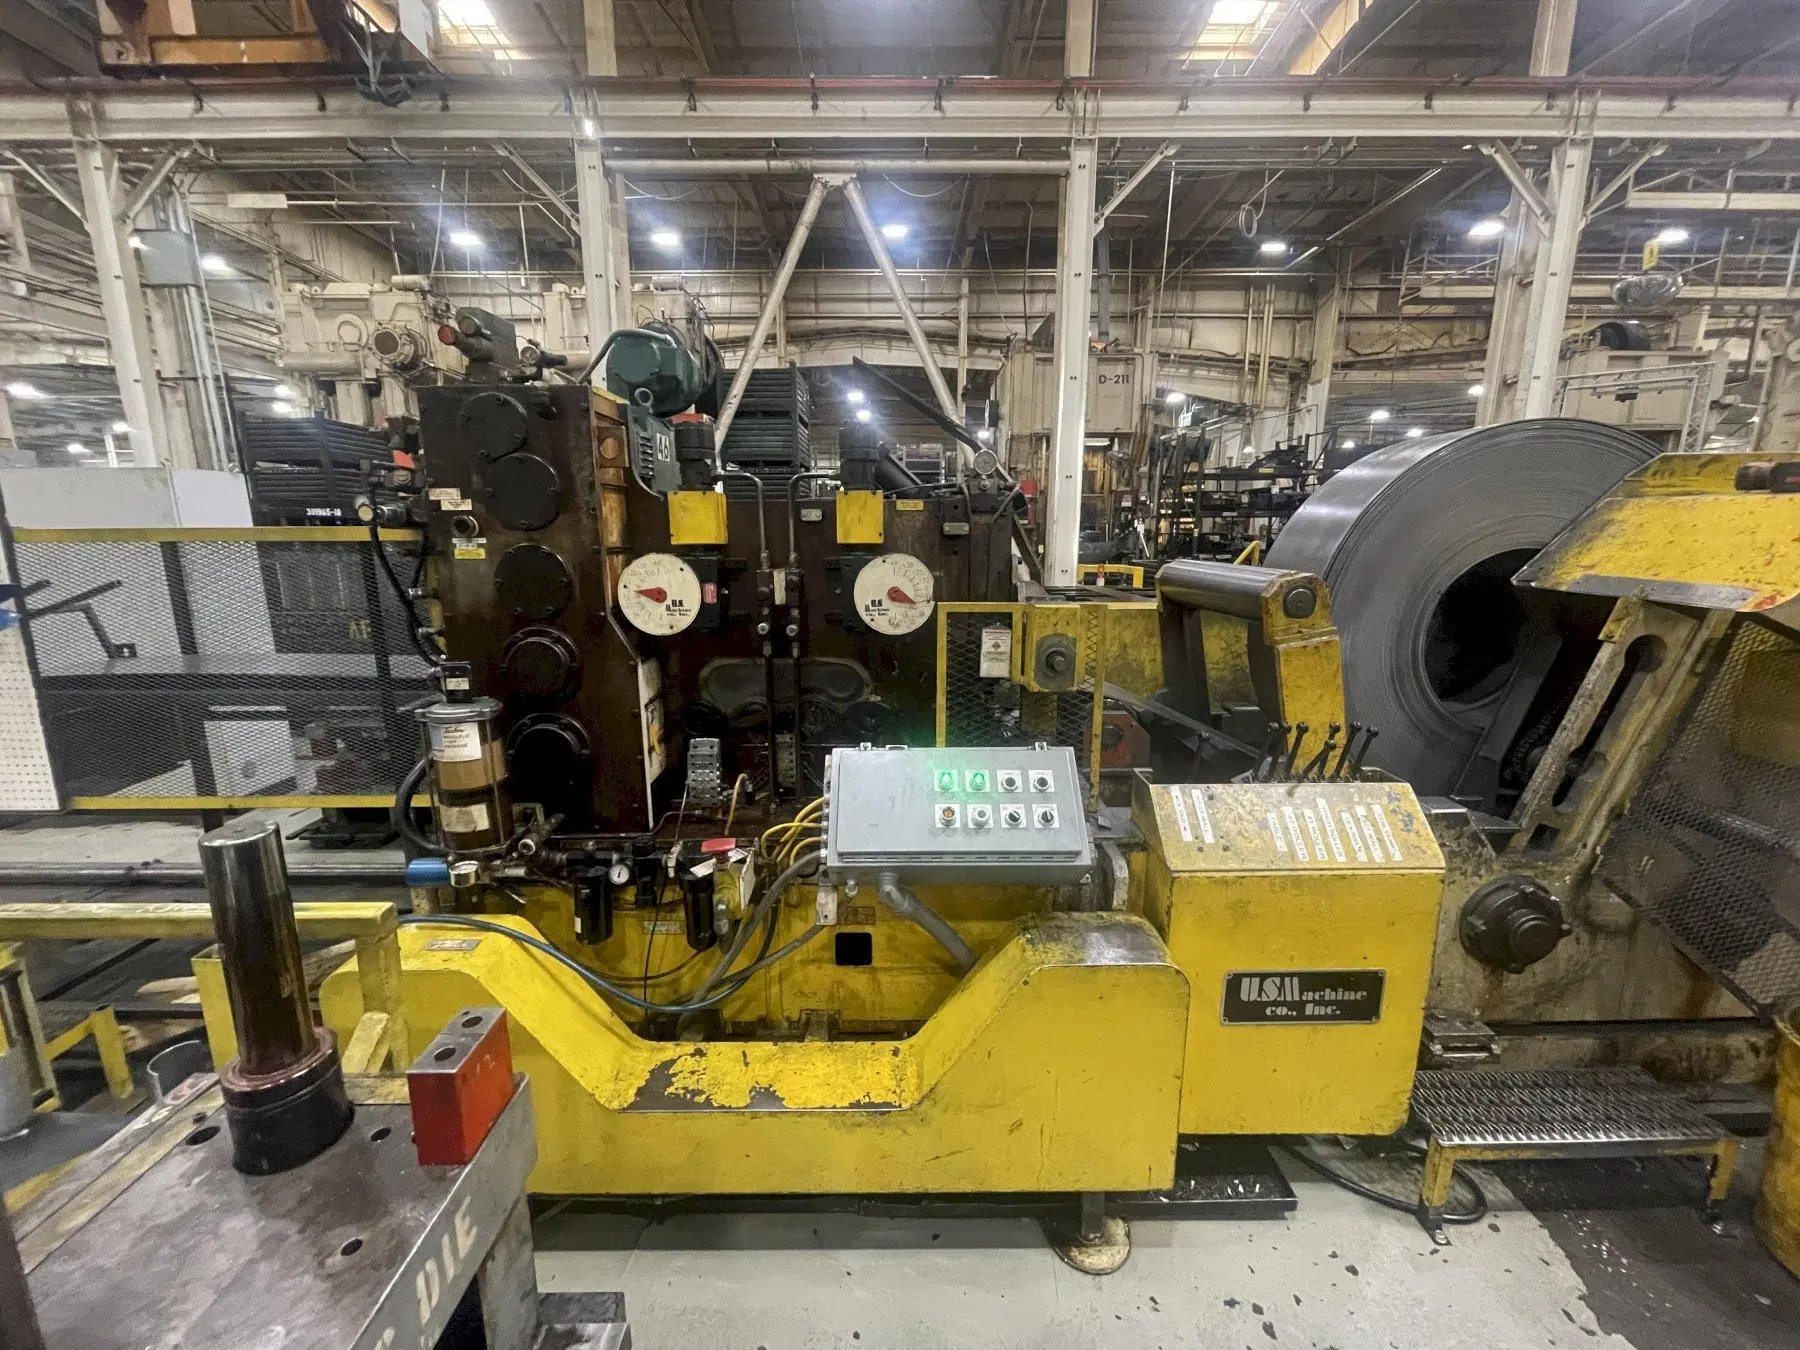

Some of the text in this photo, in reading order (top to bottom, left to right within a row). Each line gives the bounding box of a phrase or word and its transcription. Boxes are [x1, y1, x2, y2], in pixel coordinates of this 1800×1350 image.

[1098, 374, 1130, 385] D-211
[657, 433, 670, 461] 46
[1290, 826, 1308, 860] ROLLER
[1309, 825, 1327, 859] ROLLER
[1305, 1003, 1341, 1016] Inc.
[415, 1195, 478, 1325] DIE
